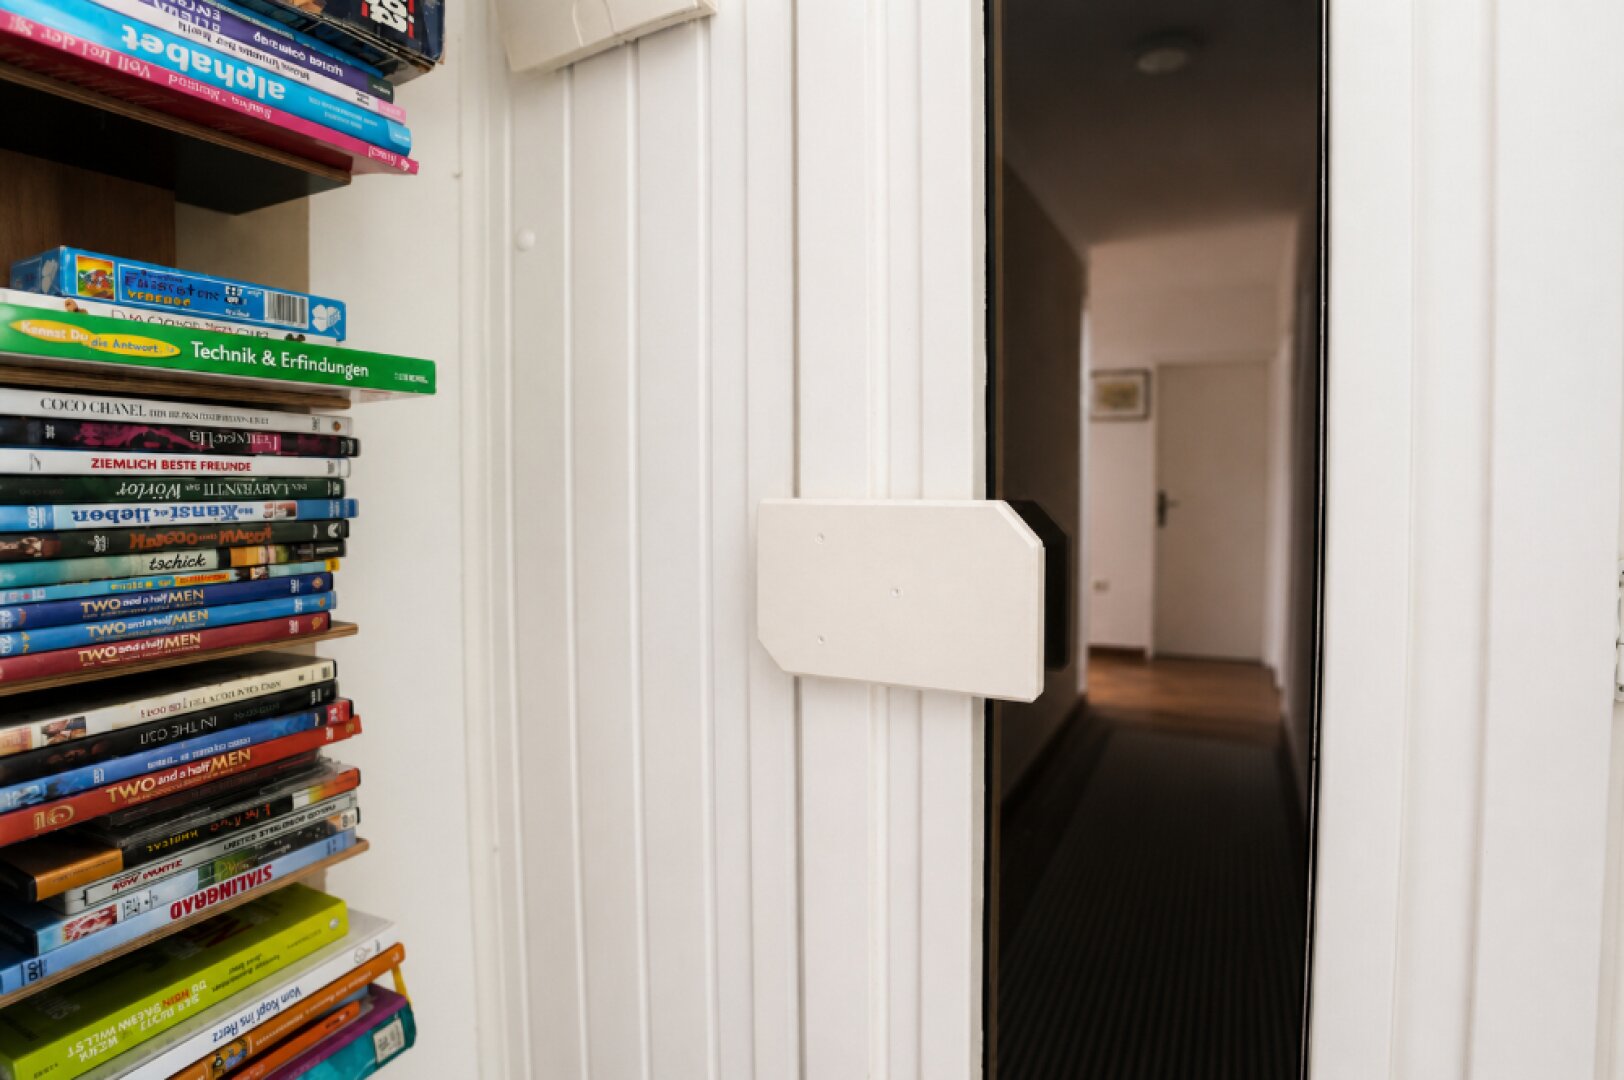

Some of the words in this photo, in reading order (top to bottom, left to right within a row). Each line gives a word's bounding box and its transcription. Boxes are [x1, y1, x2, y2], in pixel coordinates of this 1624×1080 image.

[122, 24, 286, 100] alphabet
[71, 328, 89, 342] Du
[91, 337, 108, 348] die
[190, 341, 257, 365] Technik
[262, 350, 276, 366] &
[281, 352, 369, 380] Erfindungen
[40, 398, 86, 412] COCO
[90, 400, 147, 417] CHANEL
[91, 457, 157, 470] ZIEMLICH
[161, 460, 197, 470] BESTE
[200, 460, 252, 472] FREUNDE
[80, 599, 121, 614] TWO
[169, 588, 204, 603] MEN
[86, 622, 126, 638] TWO
[172, 608, 208, 625] MEN
[78, 646, 117, 662] TWO
[164, 632, 201, 648] MEN
[105, 777, 155, 803] TWO
[158, 770, 178, 785] and
[187, 761, 211, 777] half
[209, 749, 251, 774] MEN
